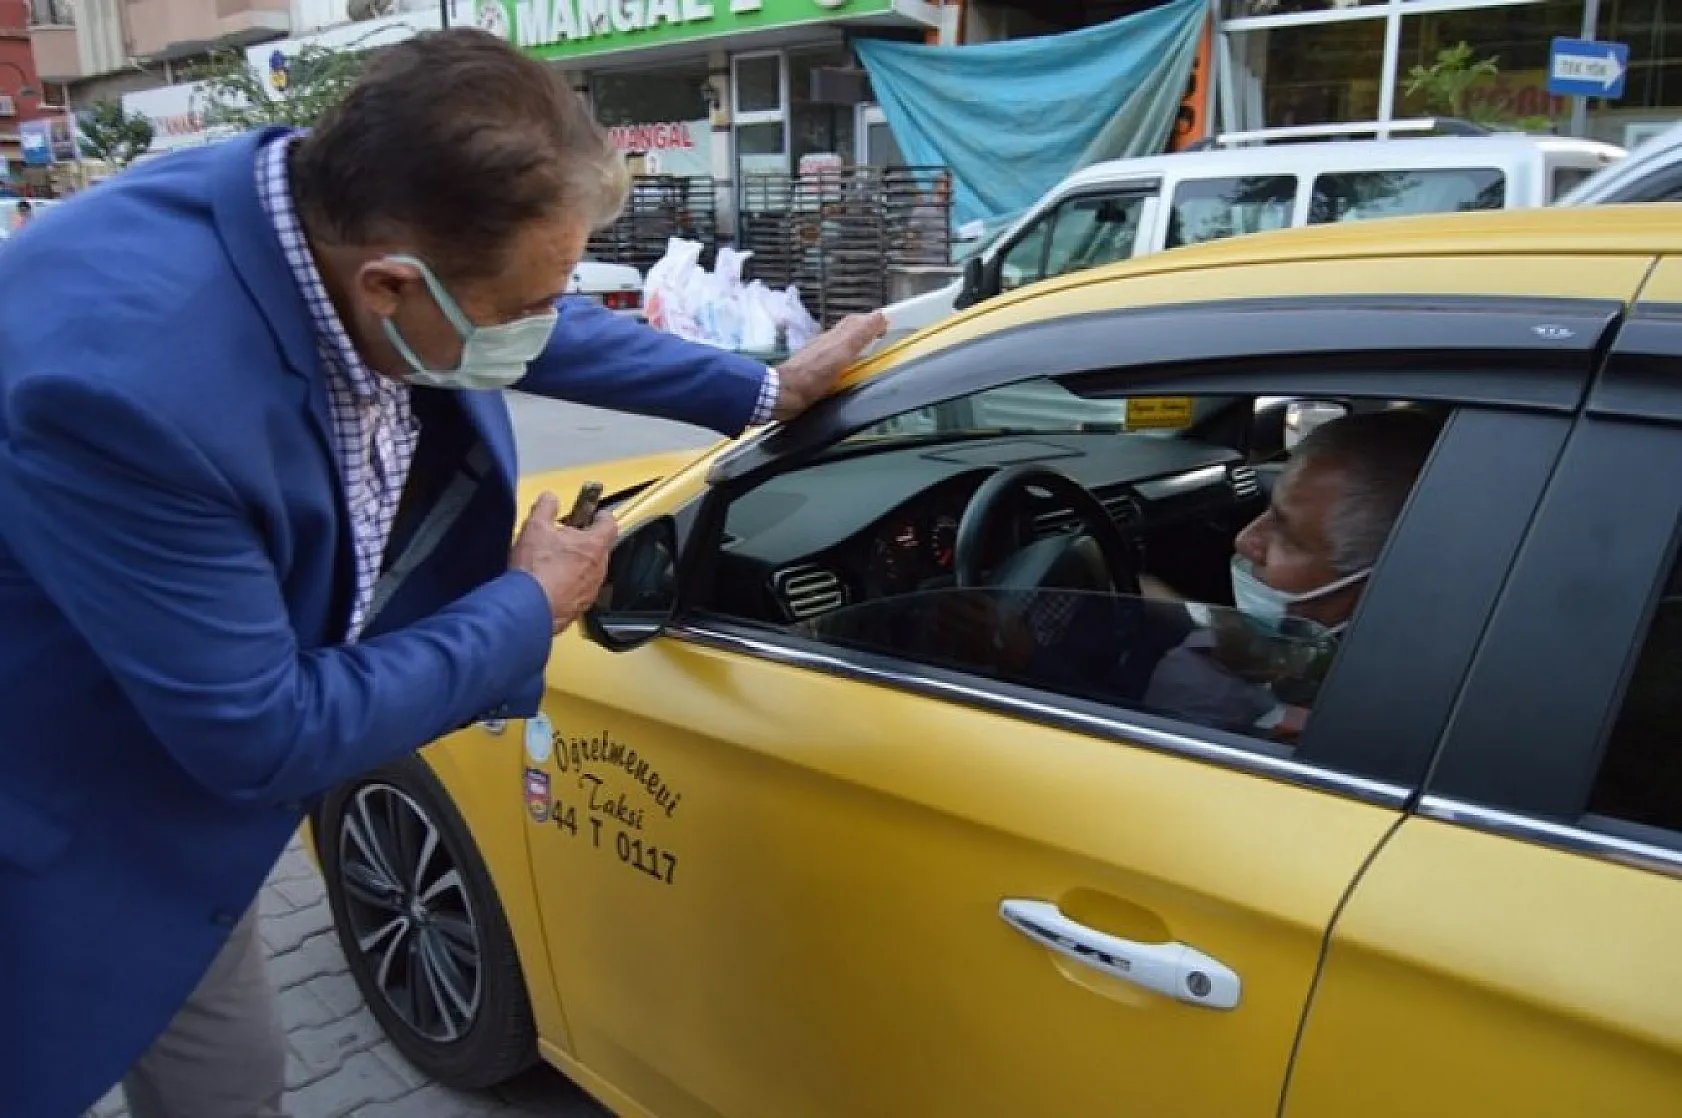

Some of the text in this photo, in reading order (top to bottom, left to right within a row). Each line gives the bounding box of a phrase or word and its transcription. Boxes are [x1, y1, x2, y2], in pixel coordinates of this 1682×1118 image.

[579, 773, 645, 830] Taksi
[551, 799, 678, 886] 44 T 0117
